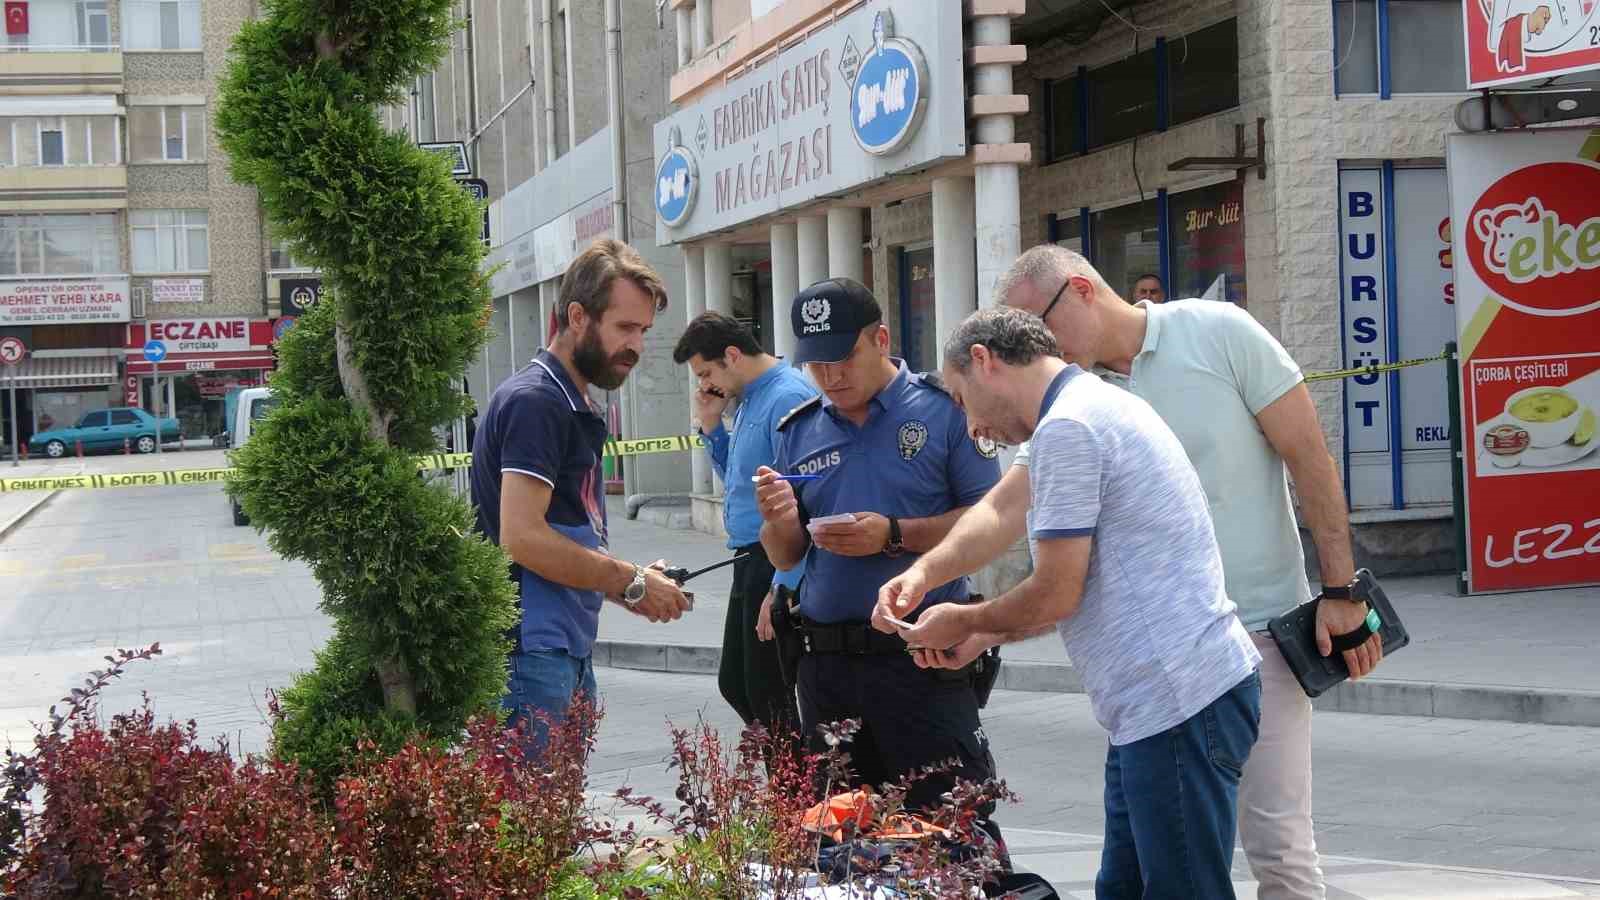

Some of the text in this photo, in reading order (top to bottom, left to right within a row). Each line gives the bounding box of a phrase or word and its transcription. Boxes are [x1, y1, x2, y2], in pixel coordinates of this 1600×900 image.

[713, 80, 776, 151] FABRİKA
[781, 48, 832, 117] SATIŞ
[715, 123, 832, 214] MAĞAZASI
[90, 292, 122, 304] KARA
[1348, 190, 1380, 427] BURSÜT
[150, 320, 246, 341] ECZANE
[803, 322, 831, 335] POLİS
[1475, 360, 1568, 385] ÇORBA ÇEŞİTLERİ
[797, 450, 841, 475] POLİS
